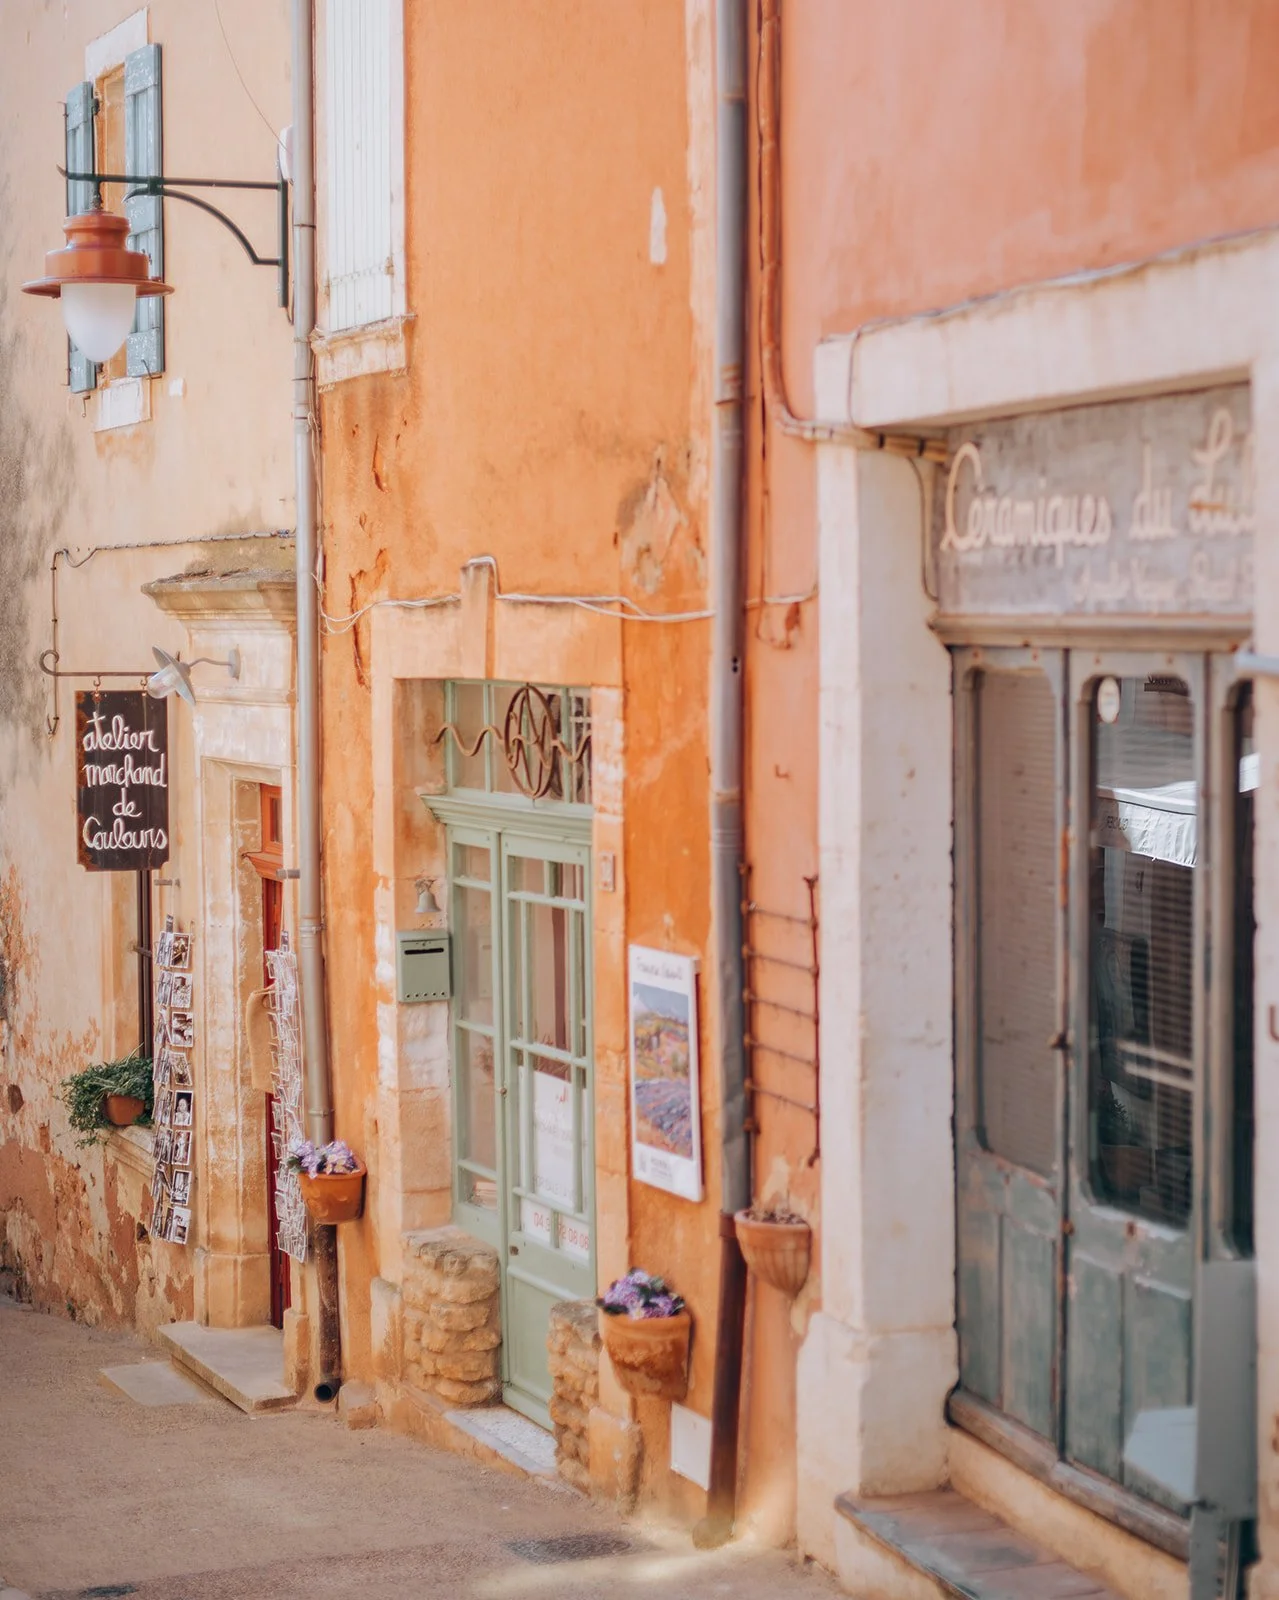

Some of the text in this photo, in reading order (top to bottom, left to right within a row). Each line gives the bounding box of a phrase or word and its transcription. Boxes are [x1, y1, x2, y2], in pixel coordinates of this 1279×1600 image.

[1129, 442, 1179, 541] du
[82, 711, 160, 752] atelier
[82, 753, 168, 788] marchand
[112, 787, 142, 818] de
[82, 816, 168, 850] Couleurs
